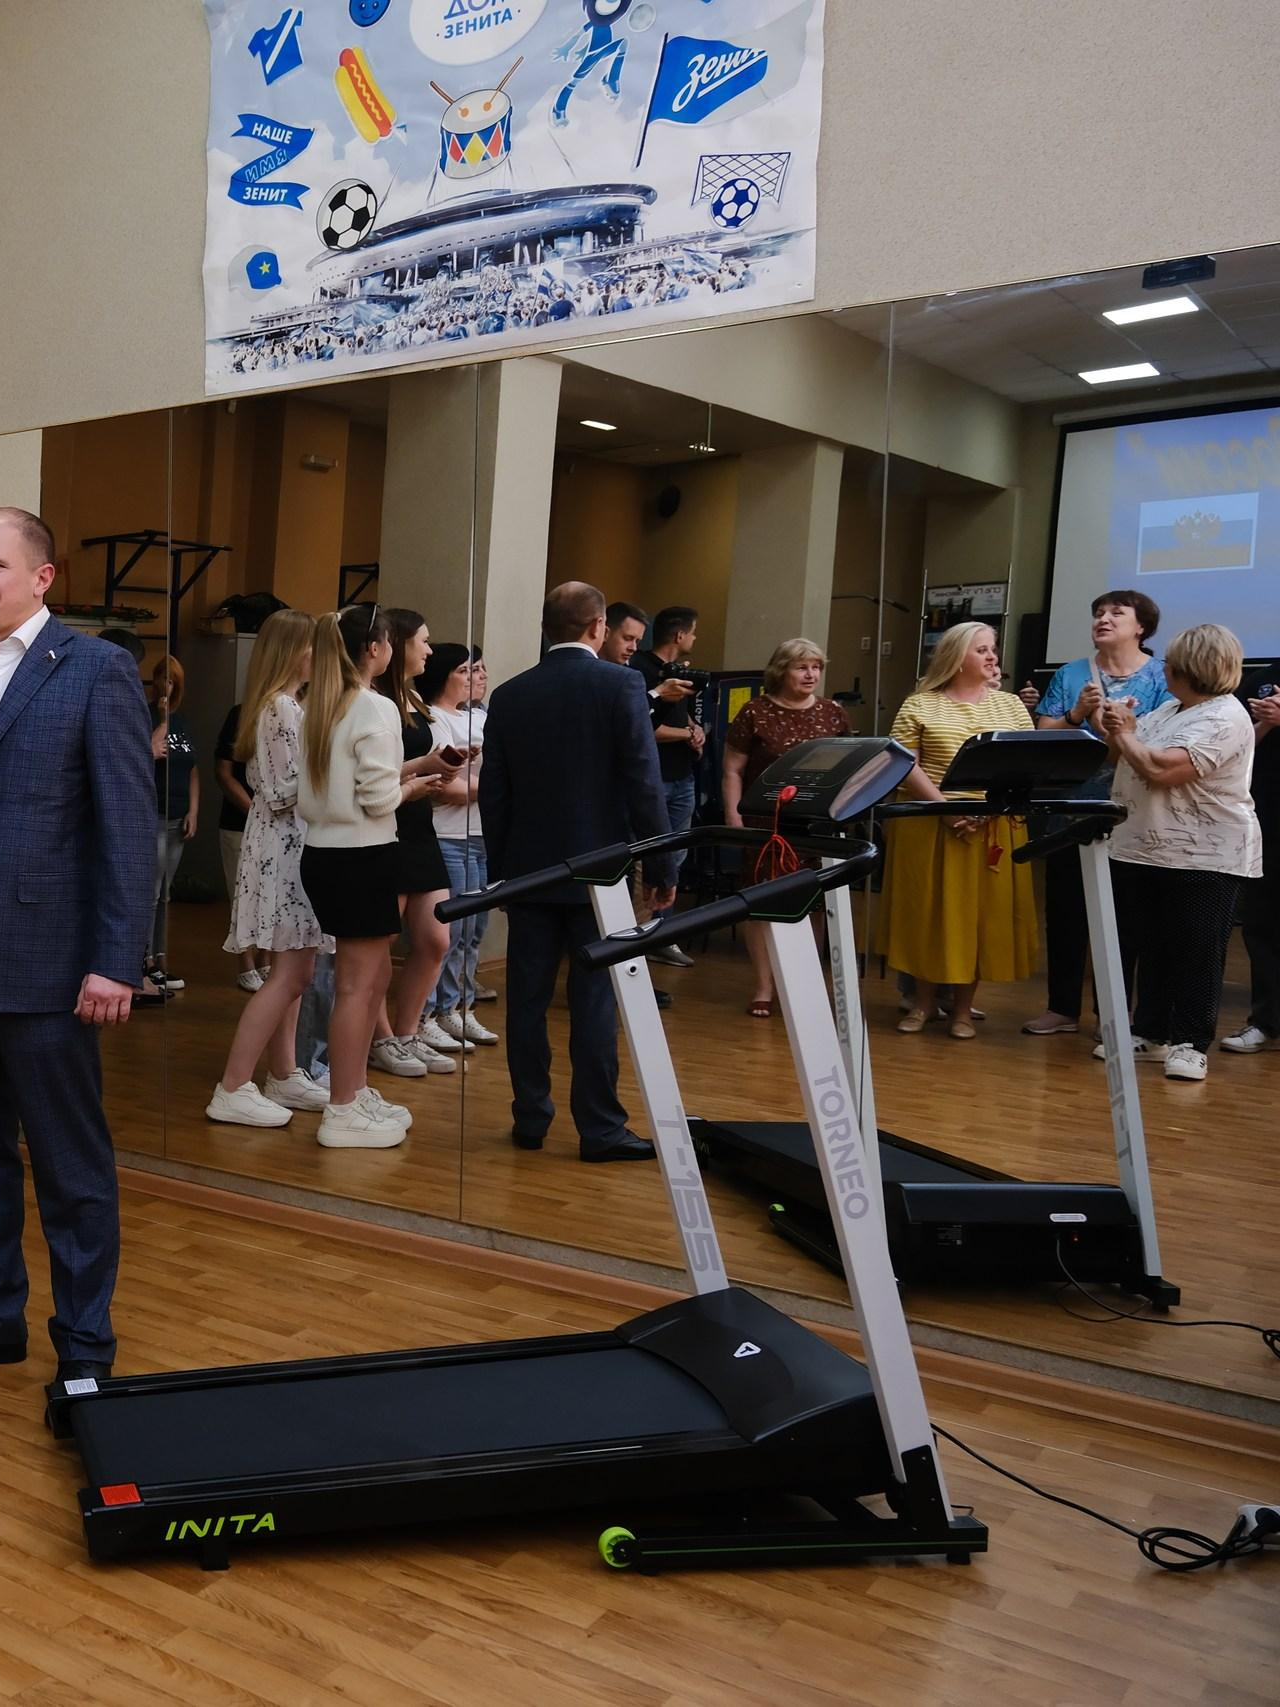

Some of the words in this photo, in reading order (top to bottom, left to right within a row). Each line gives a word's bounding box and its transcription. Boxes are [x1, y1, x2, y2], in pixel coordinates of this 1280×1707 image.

[444, 8, 513, 39] ЗЕНИТА
[252, 122, 294, 144] НАШЕ
[244, 148, 288, 183] ИМЯ
[243, 187, 289, 201] ЗЕНИТ
[814, 1065, 870, 1220] TORNEO
[656, 1105, 721, 1273] T-155
[165, 1512, 275, 1541] INITA
